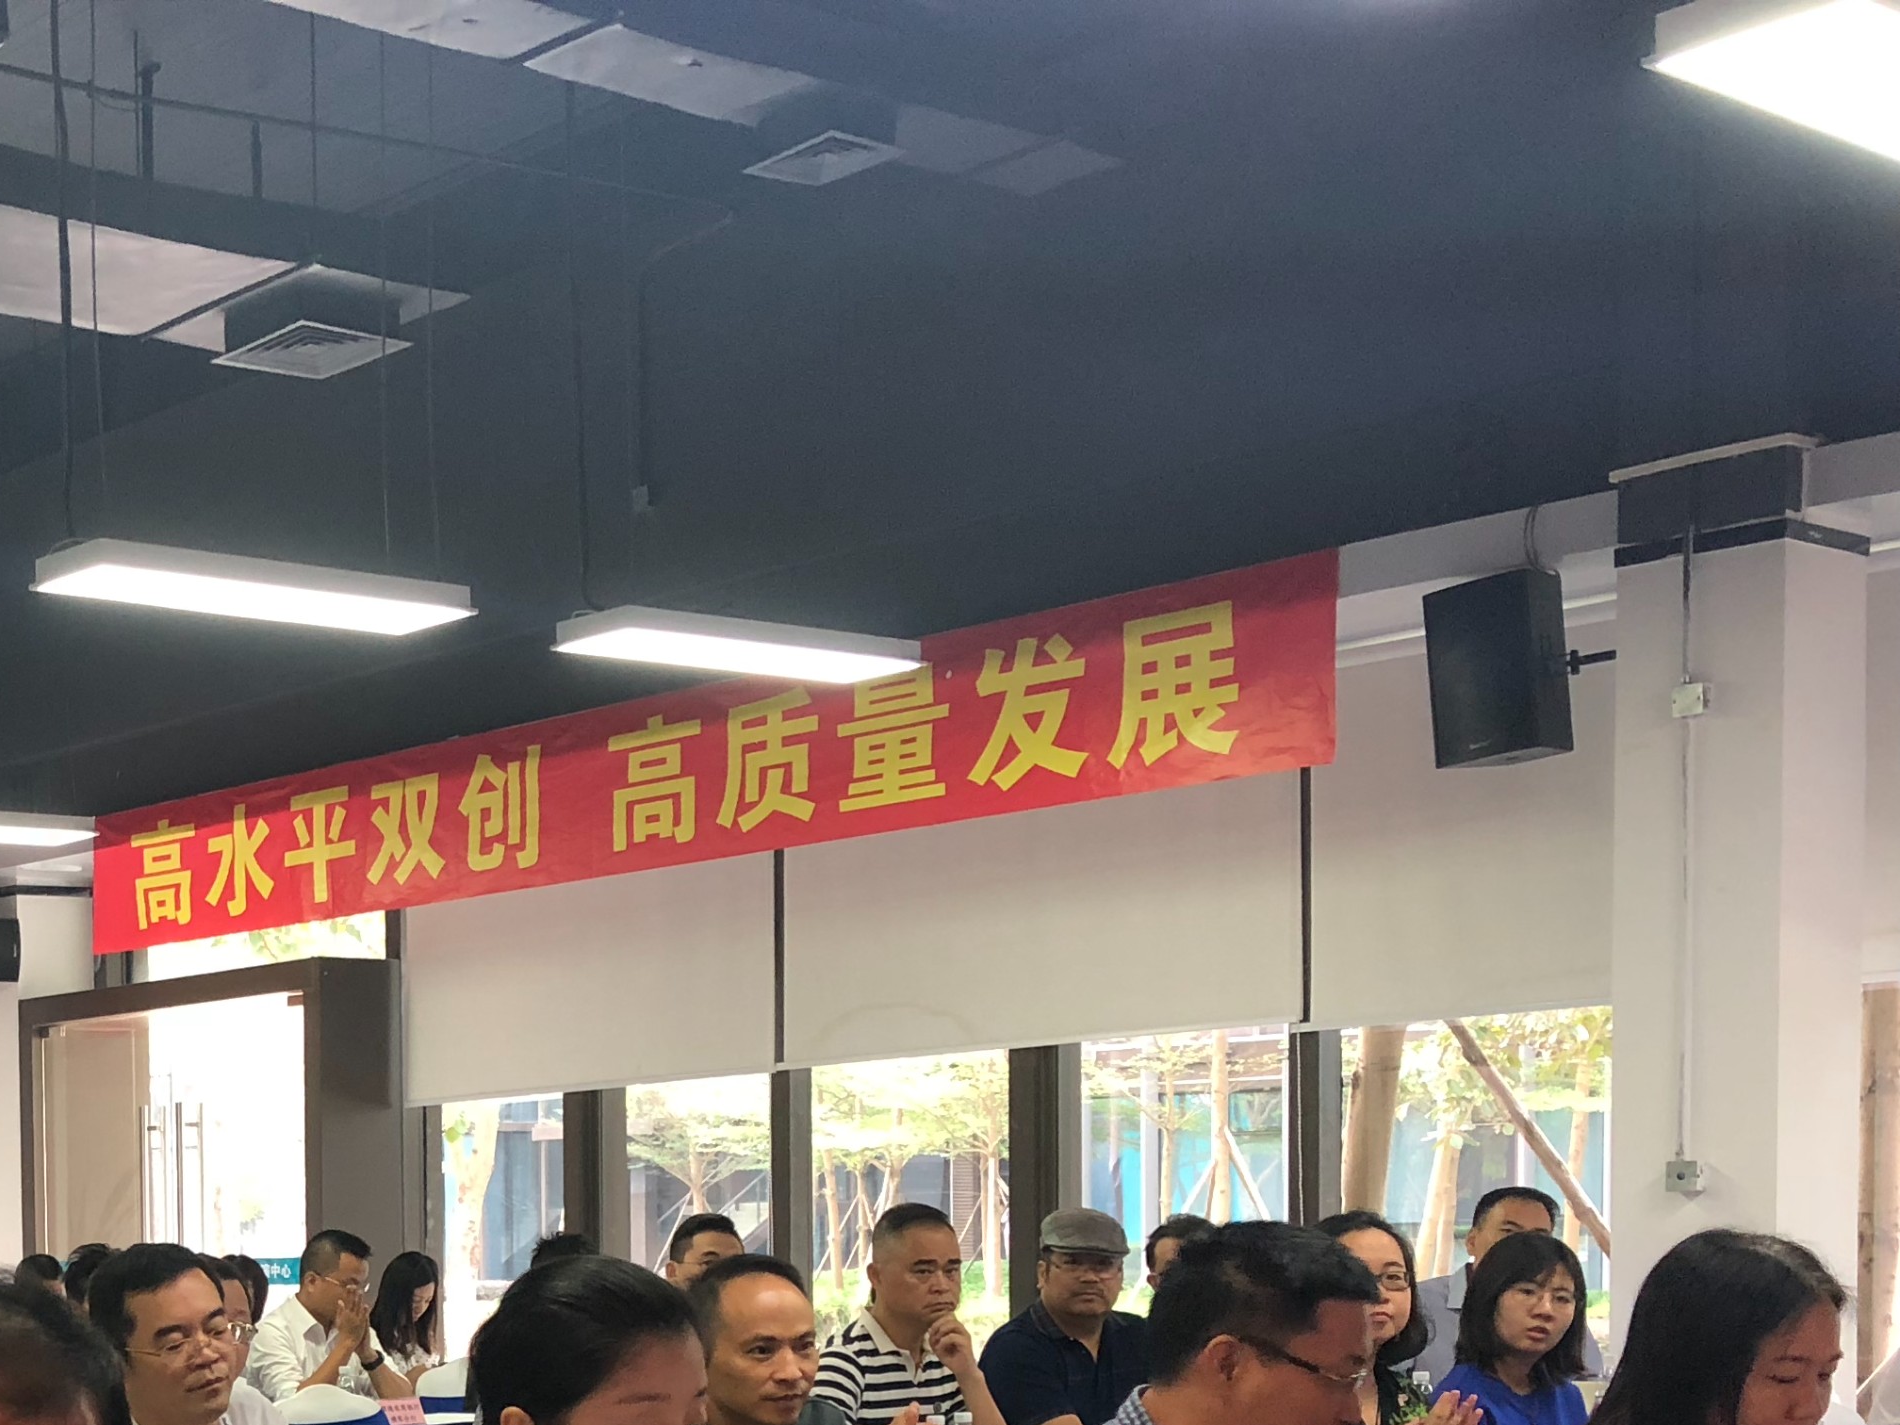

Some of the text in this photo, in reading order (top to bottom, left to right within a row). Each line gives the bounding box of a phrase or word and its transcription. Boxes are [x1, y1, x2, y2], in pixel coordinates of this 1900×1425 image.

[130, 601, 1239, 932] 高水平双创 高质量发展
